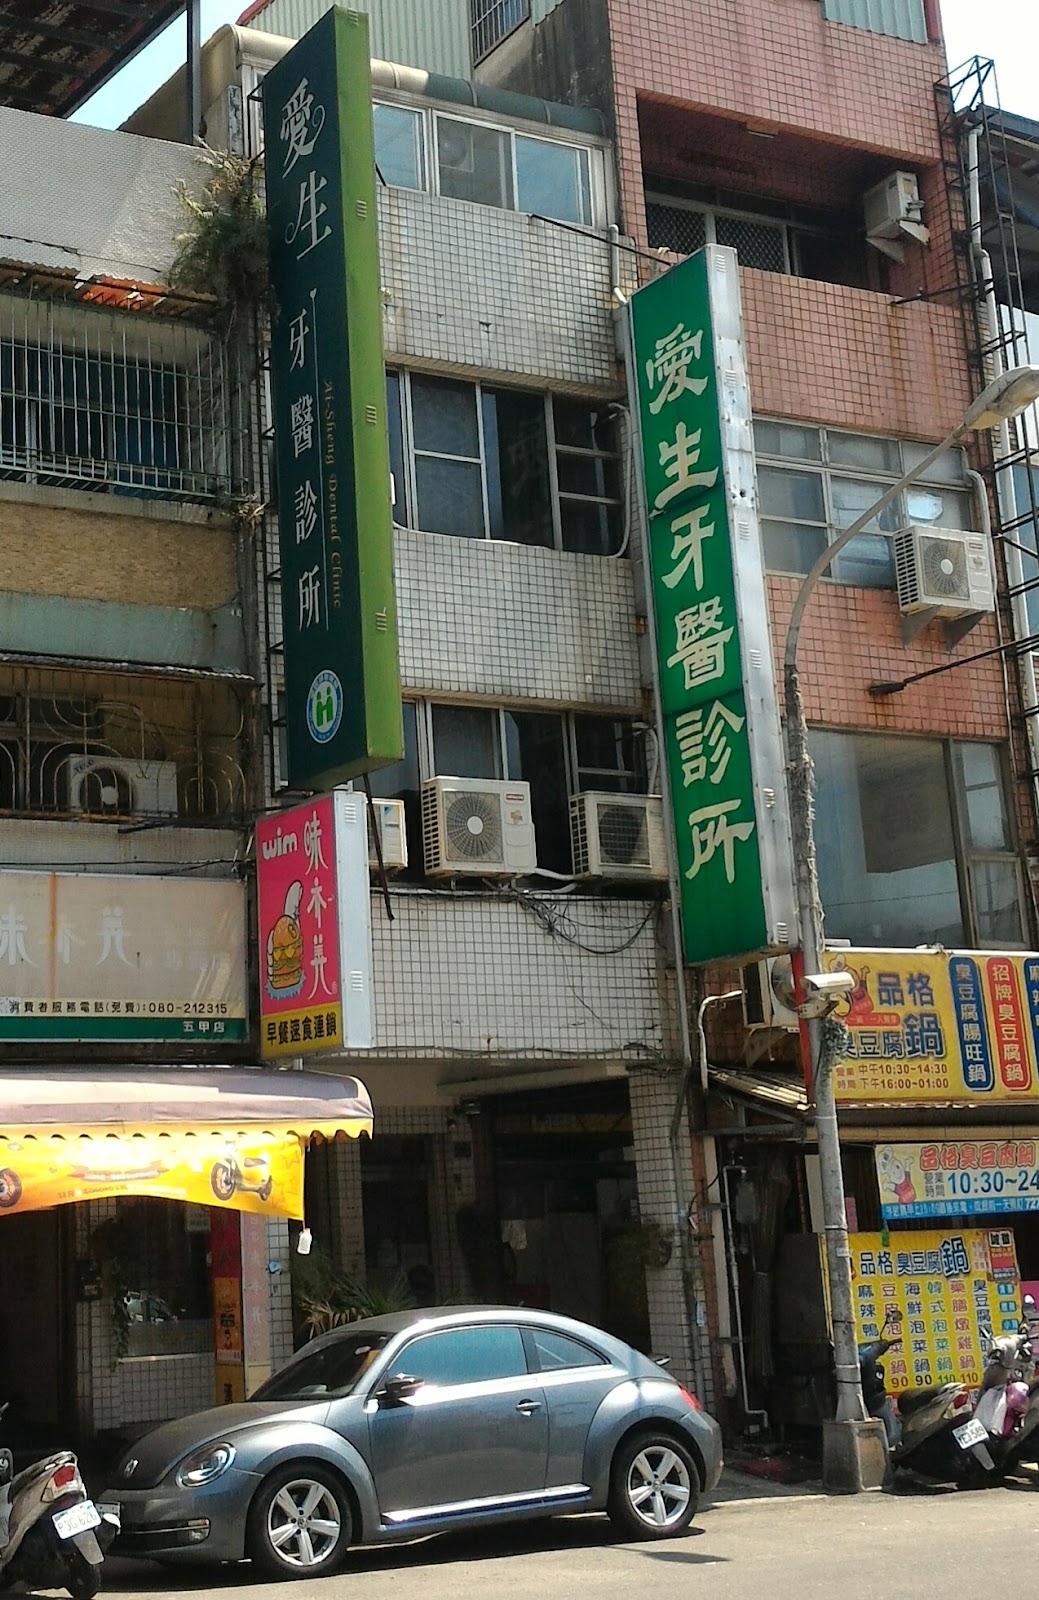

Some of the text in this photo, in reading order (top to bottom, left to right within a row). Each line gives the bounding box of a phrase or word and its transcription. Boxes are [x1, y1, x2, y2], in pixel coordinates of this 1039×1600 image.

[324, 381, 343, 609] Ai-Sheng Dental Clinic
[645, 322, 755, 884] 愛生牙醫診所
[262, 827, 298, 860] wim
[877, 972, 935, 1007] 品格
[182, 1020, 225, 1033] 五甲店
[266, 1013, 337, 1047] 早餐速食連鎖
[955, 963, 987, 1083] 臭豆腐腸旺鍋
[992, 964, 1024, 1082] 招牌臭豆腐鍋
[921, 1142, 1036, 1171] 品格臭豆腐鍋
[891, 1376, 909, 1389] 90
[915, 1374, 933, 1387] 90
[960, 1372, 979, 1384] 110
